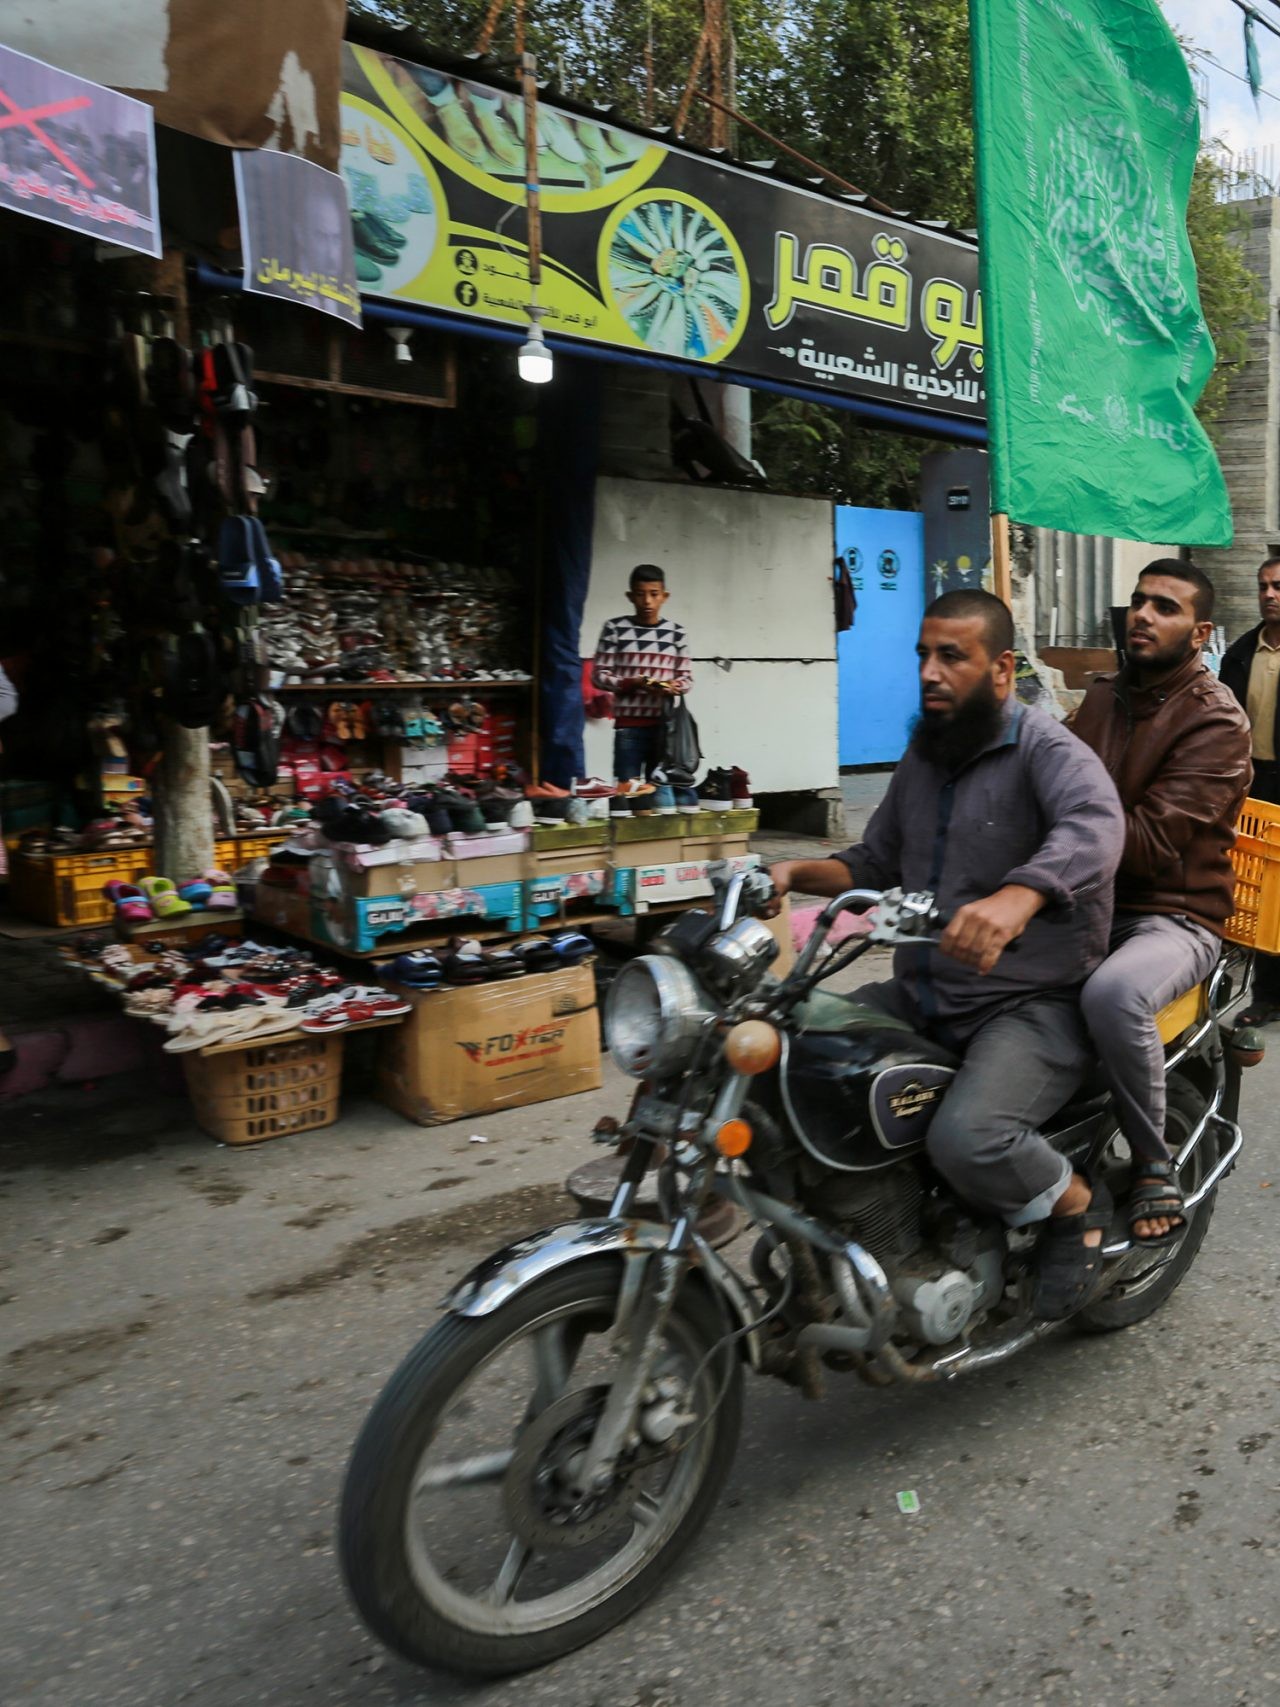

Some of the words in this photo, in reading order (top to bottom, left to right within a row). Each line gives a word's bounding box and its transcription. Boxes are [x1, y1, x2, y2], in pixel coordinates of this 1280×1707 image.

[763, 231, 912, 332] قمر
[920, 277, 984, 373] بو
[797, 338, 899, 387] الشعبية
[903, 362, 979, 404] للأحذية
